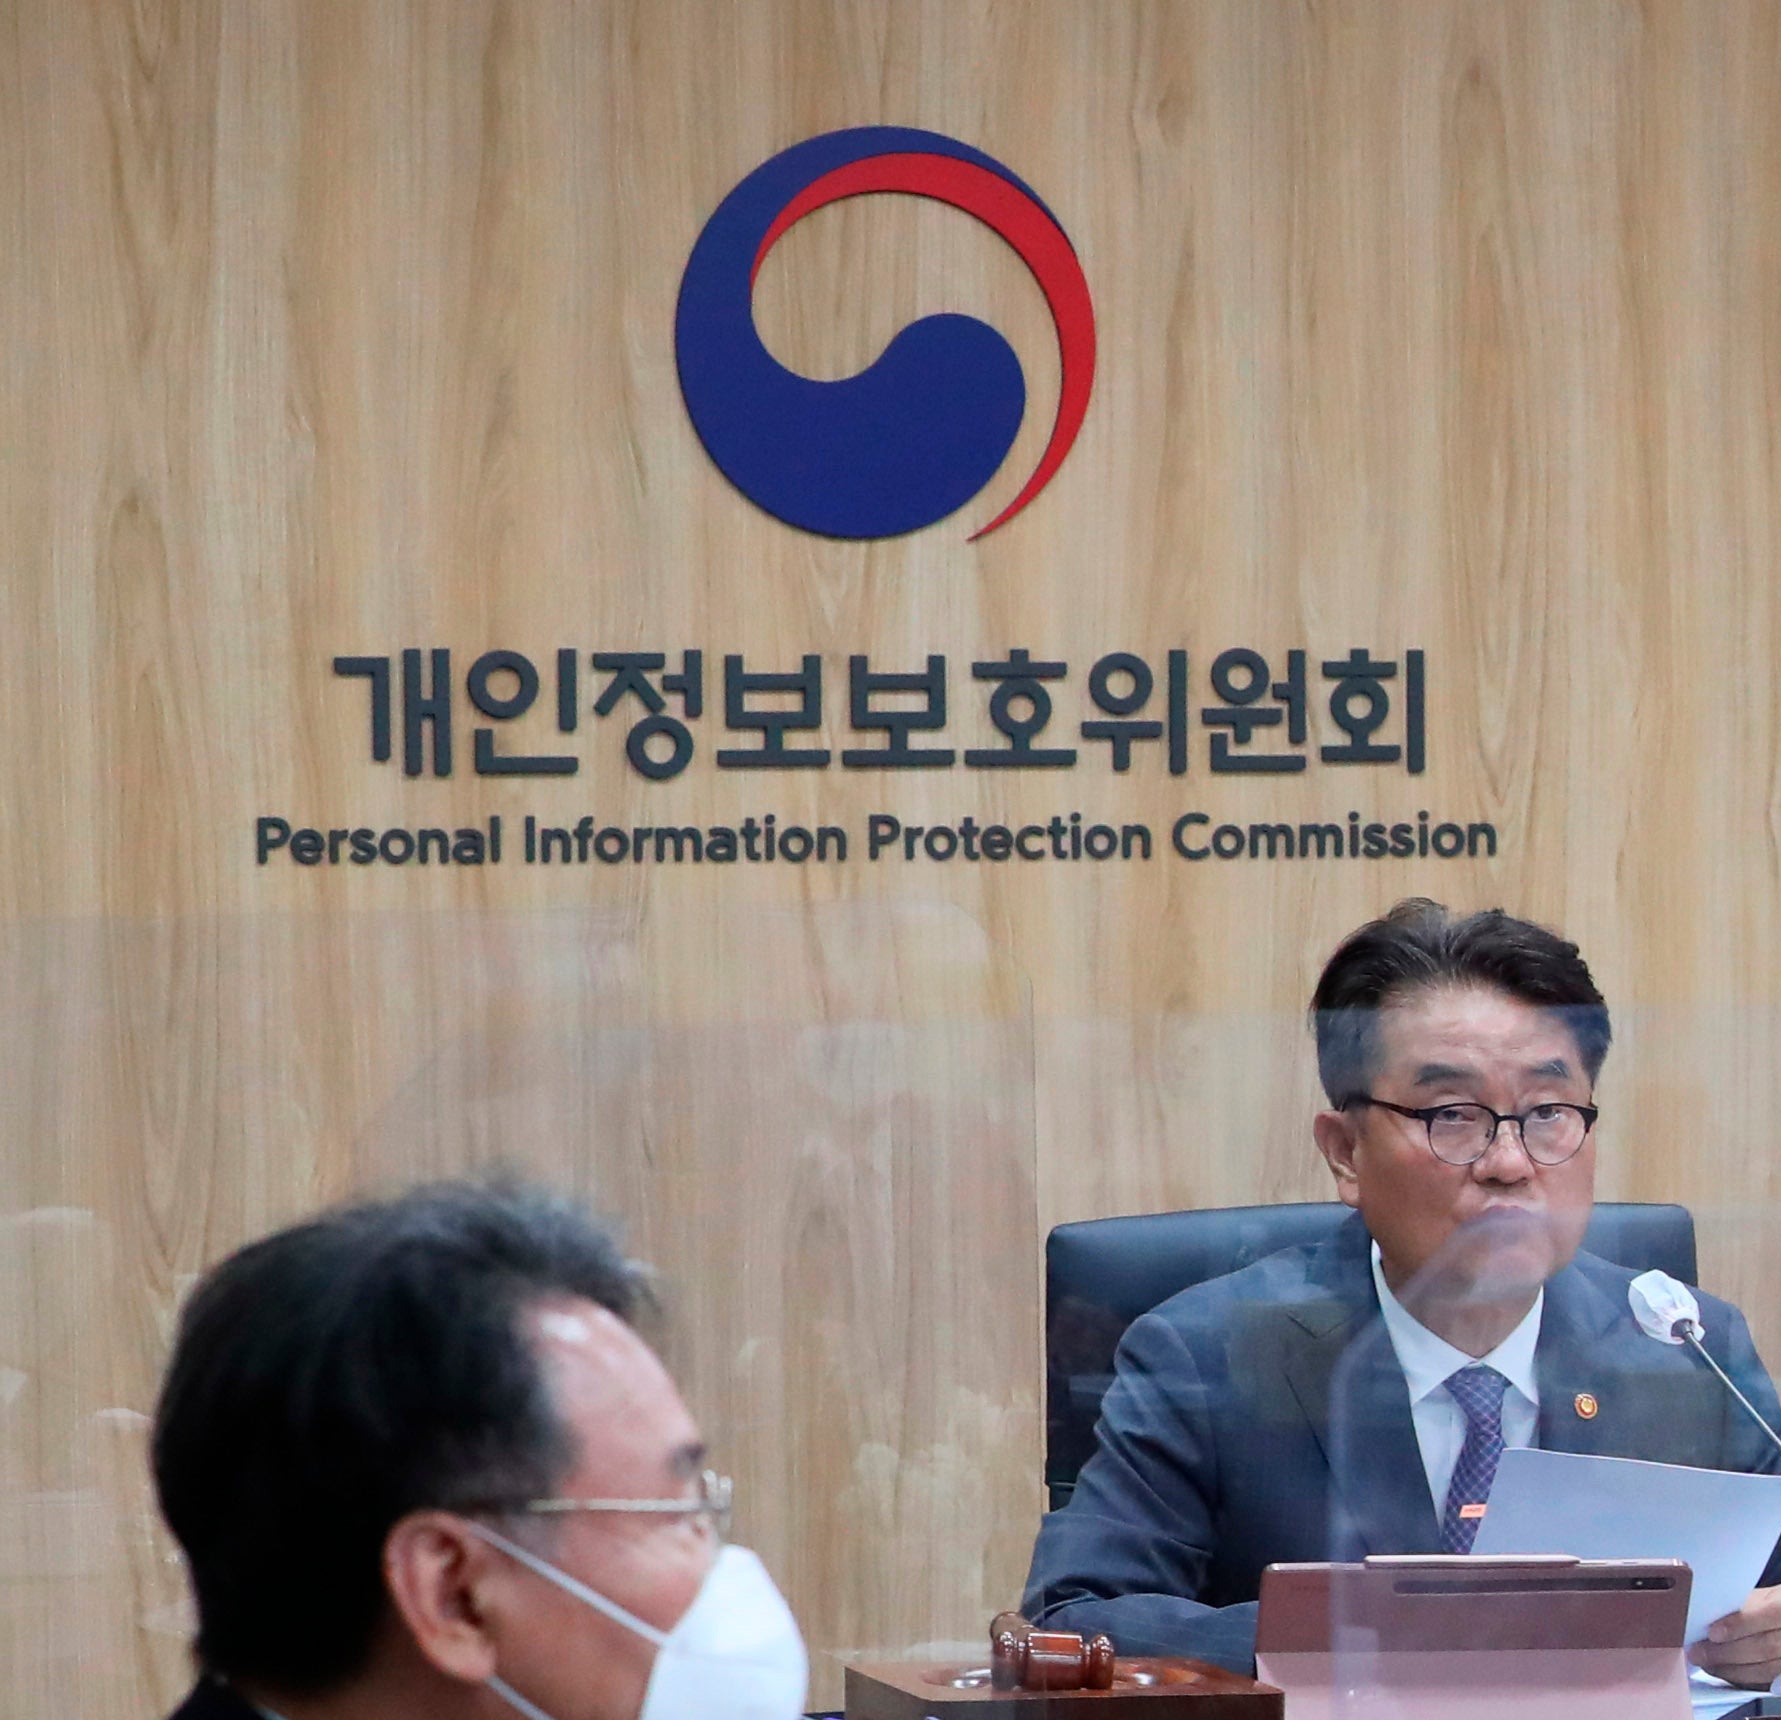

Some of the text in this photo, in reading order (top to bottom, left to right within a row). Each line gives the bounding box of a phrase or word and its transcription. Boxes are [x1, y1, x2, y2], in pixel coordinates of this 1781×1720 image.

[331, 647, 1426, 782] 개인정보보호위원회
[255, 809, 1498, 867] Personal Information Protection Commission
